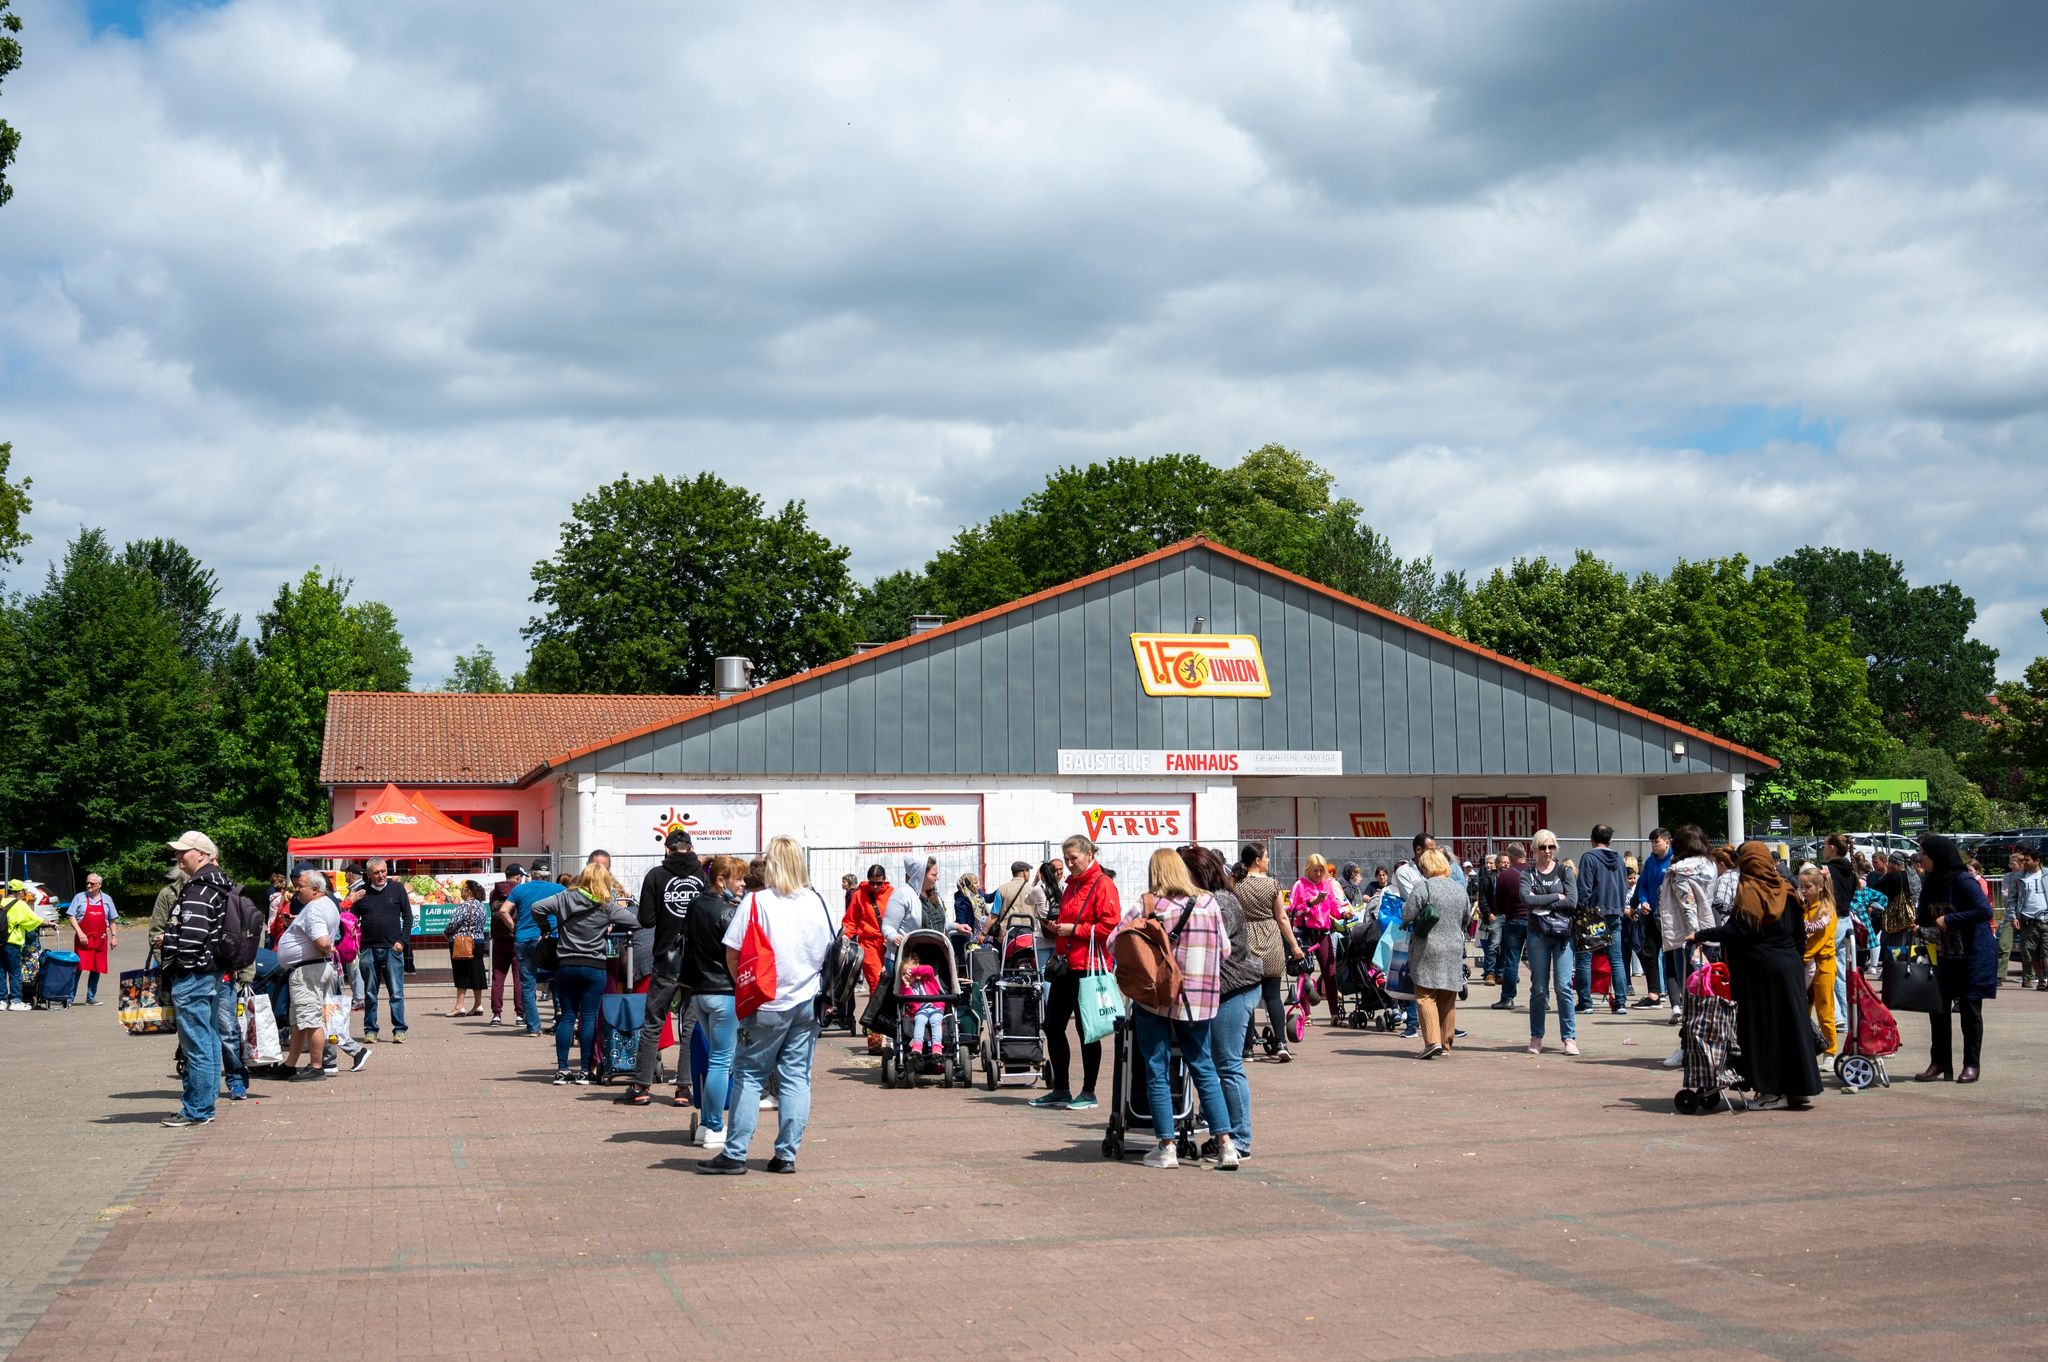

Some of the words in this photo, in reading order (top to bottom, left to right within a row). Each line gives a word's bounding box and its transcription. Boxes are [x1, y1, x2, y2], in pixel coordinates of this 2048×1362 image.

[1208, 658, 1260, 682] UNION
[1062, 753, 1151, 771] BAUSTELLE
[1166, 754, 1239, 771] FANHAUS
[1901, 792, 1919, 802] BIG
[920, 815, 946, 826] UNION
[1349, 812, 1392, 837] FUMA
[1464, 806, 1487, 822] NICHT
[1488, 806, 1536, 838] LIEBE
[1464, 823, 1487, 840] OHNE
[1098, 1006, 1117, 1017] DEIN
